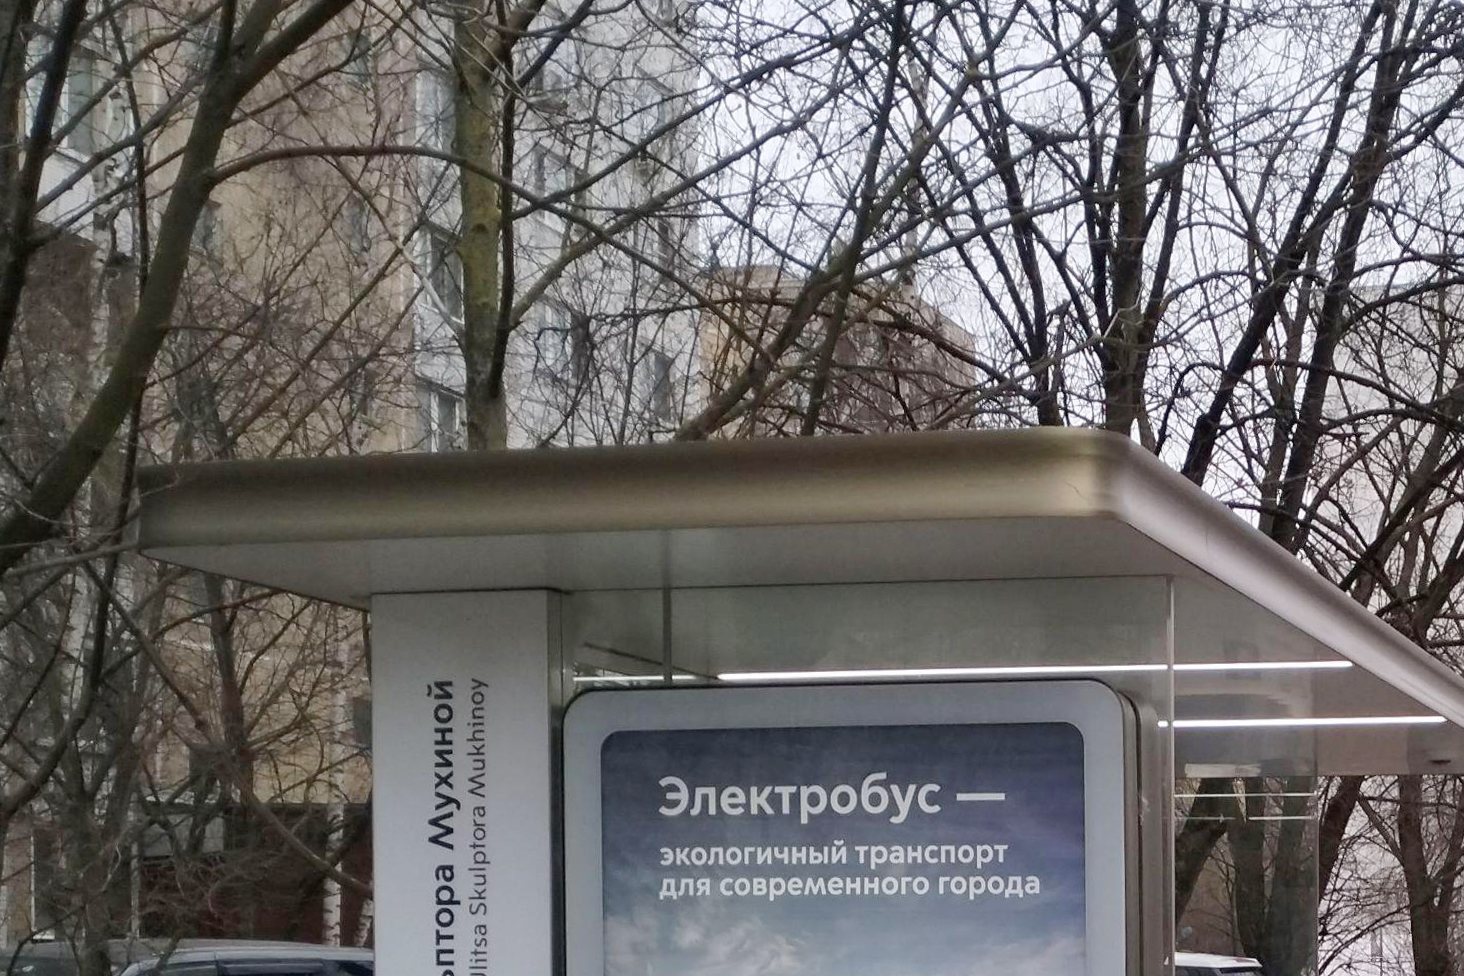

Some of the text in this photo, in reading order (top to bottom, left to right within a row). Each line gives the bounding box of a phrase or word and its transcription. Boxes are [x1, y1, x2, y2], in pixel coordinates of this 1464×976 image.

[427, 680, 461, 850] Мухиной
[466, 677, 489, 798] Mukhinoy
[658, 772, 941, 824] Электробус
[468, 805, 490, 916] Skulptora
[659, 839, 1008, 870] экологичный транспорт
[659, 873, 1041, 902] для современного города
